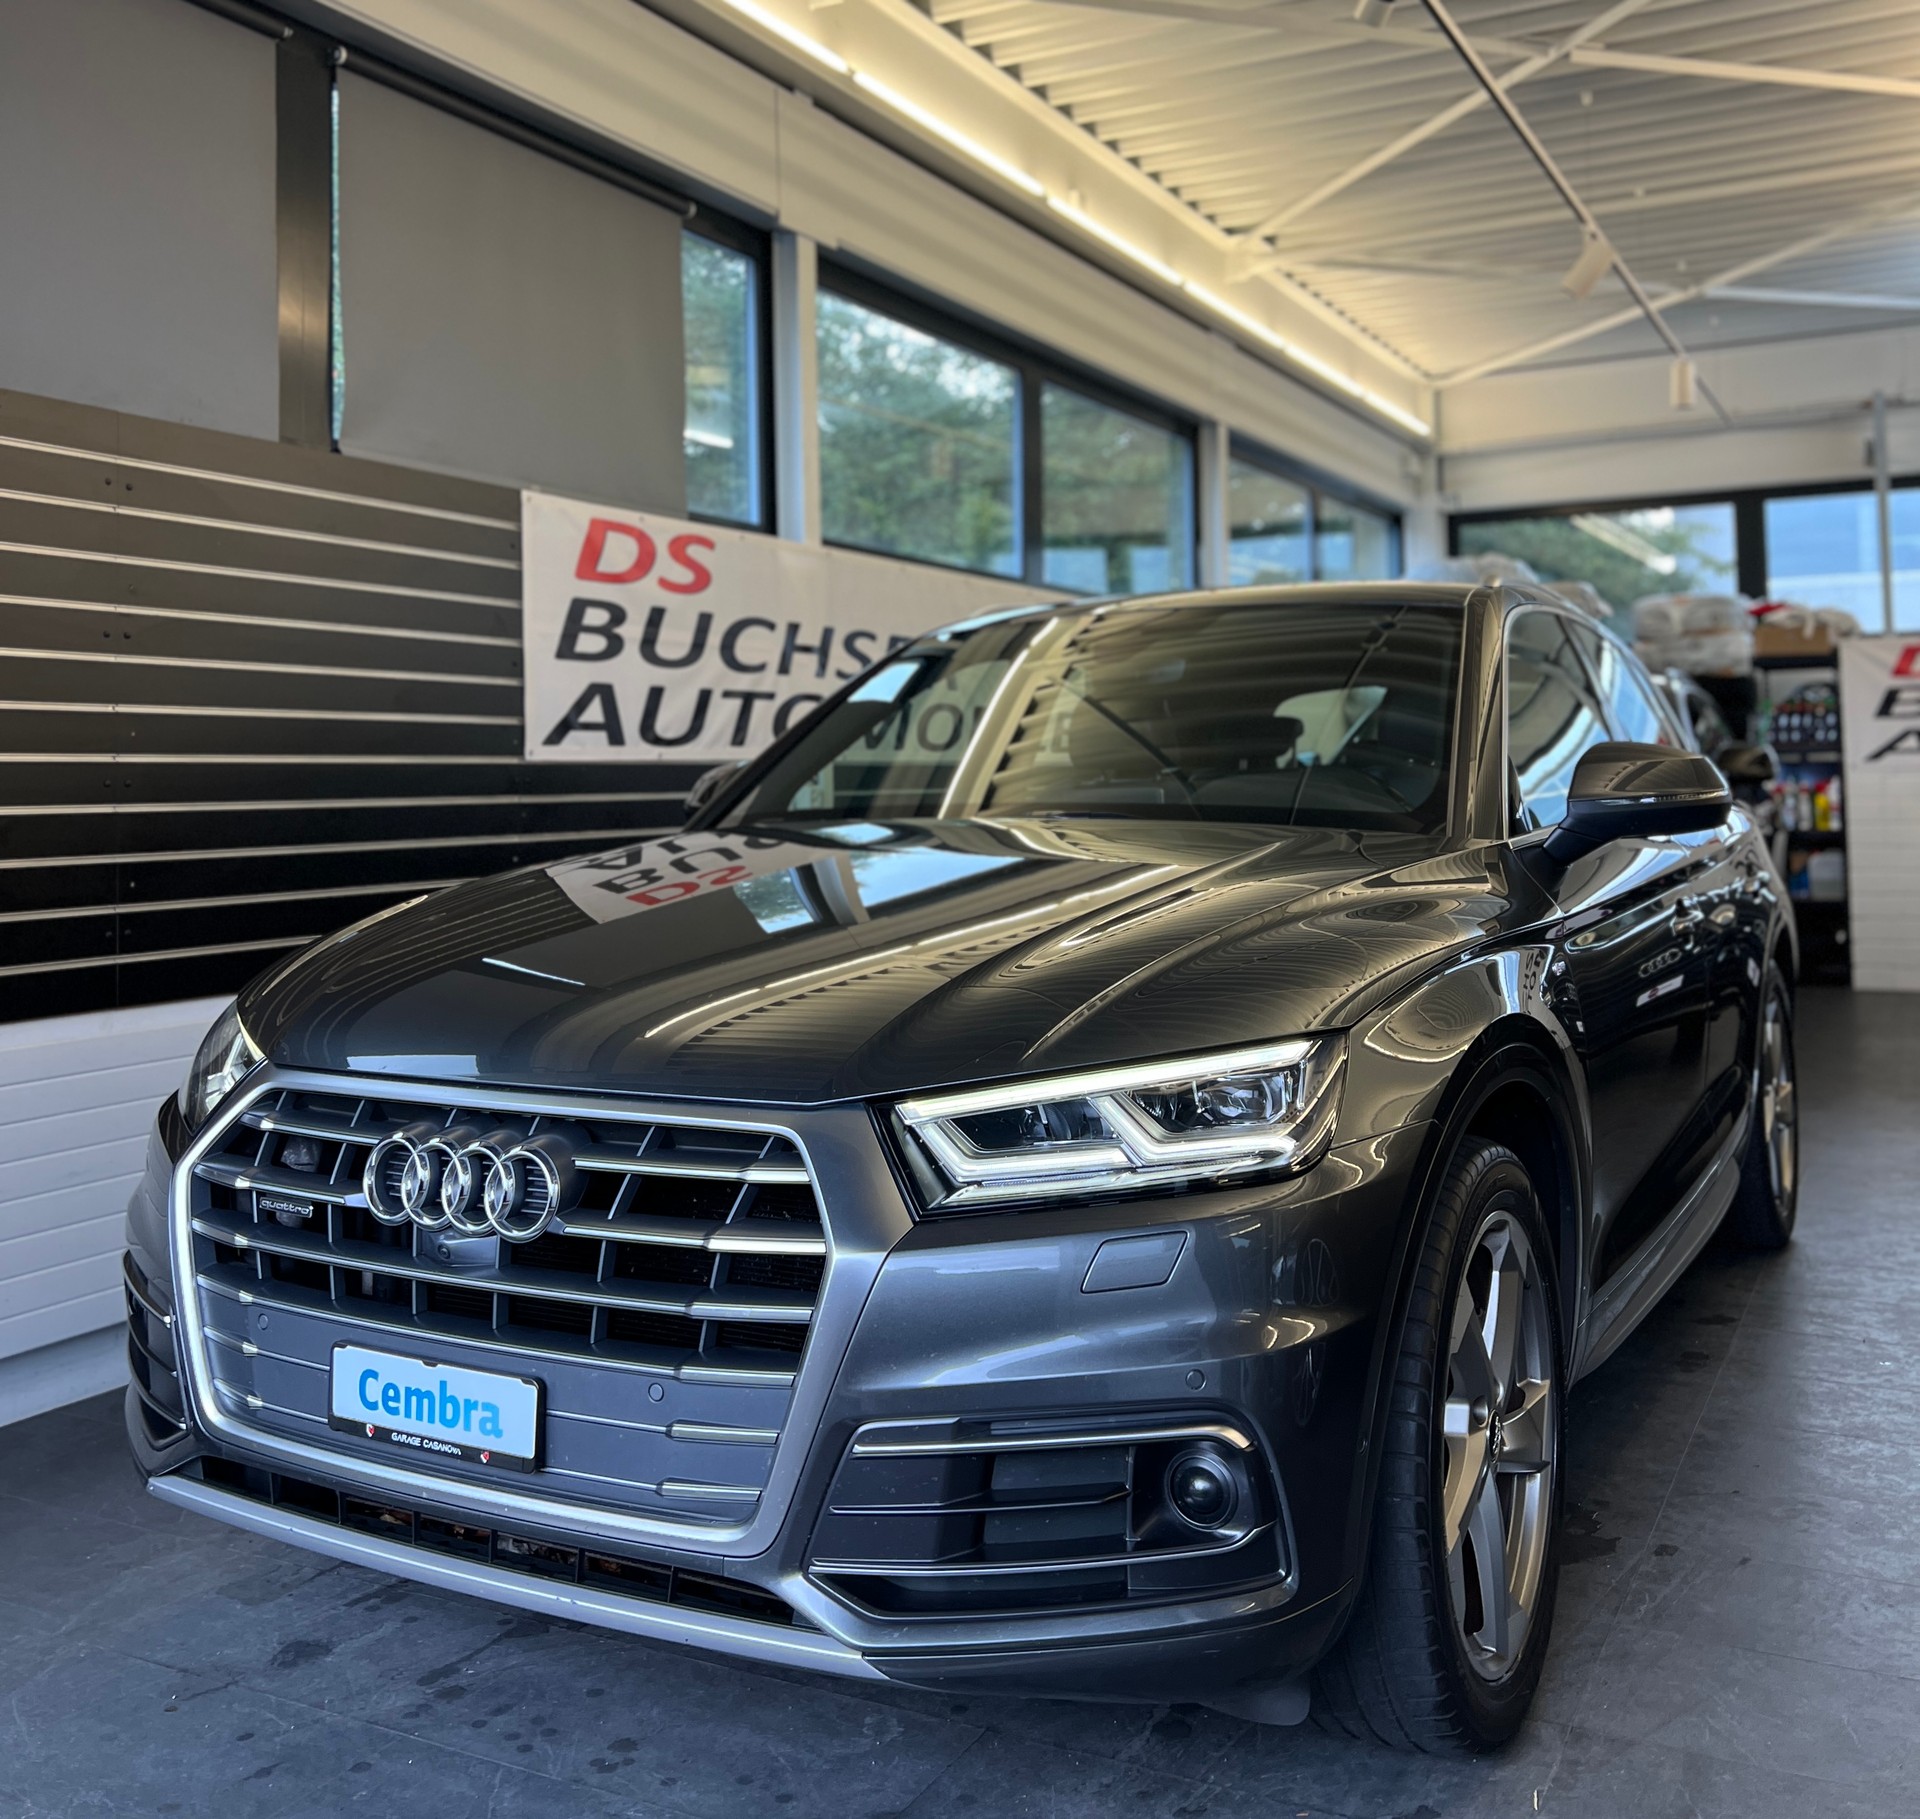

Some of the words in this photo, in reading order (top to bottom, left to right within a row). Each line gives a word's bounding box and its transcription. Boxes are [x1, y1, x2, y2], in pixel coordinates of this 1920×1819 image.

[575, 518, 715, 594] DS
[261, 1199, 310, 1215] quattro
[358, 1369, 504, 1439] Cembra
[391, 1432, 422, 1447] GARAGE
[423, 1439, 462, 1456] CASANOVA
